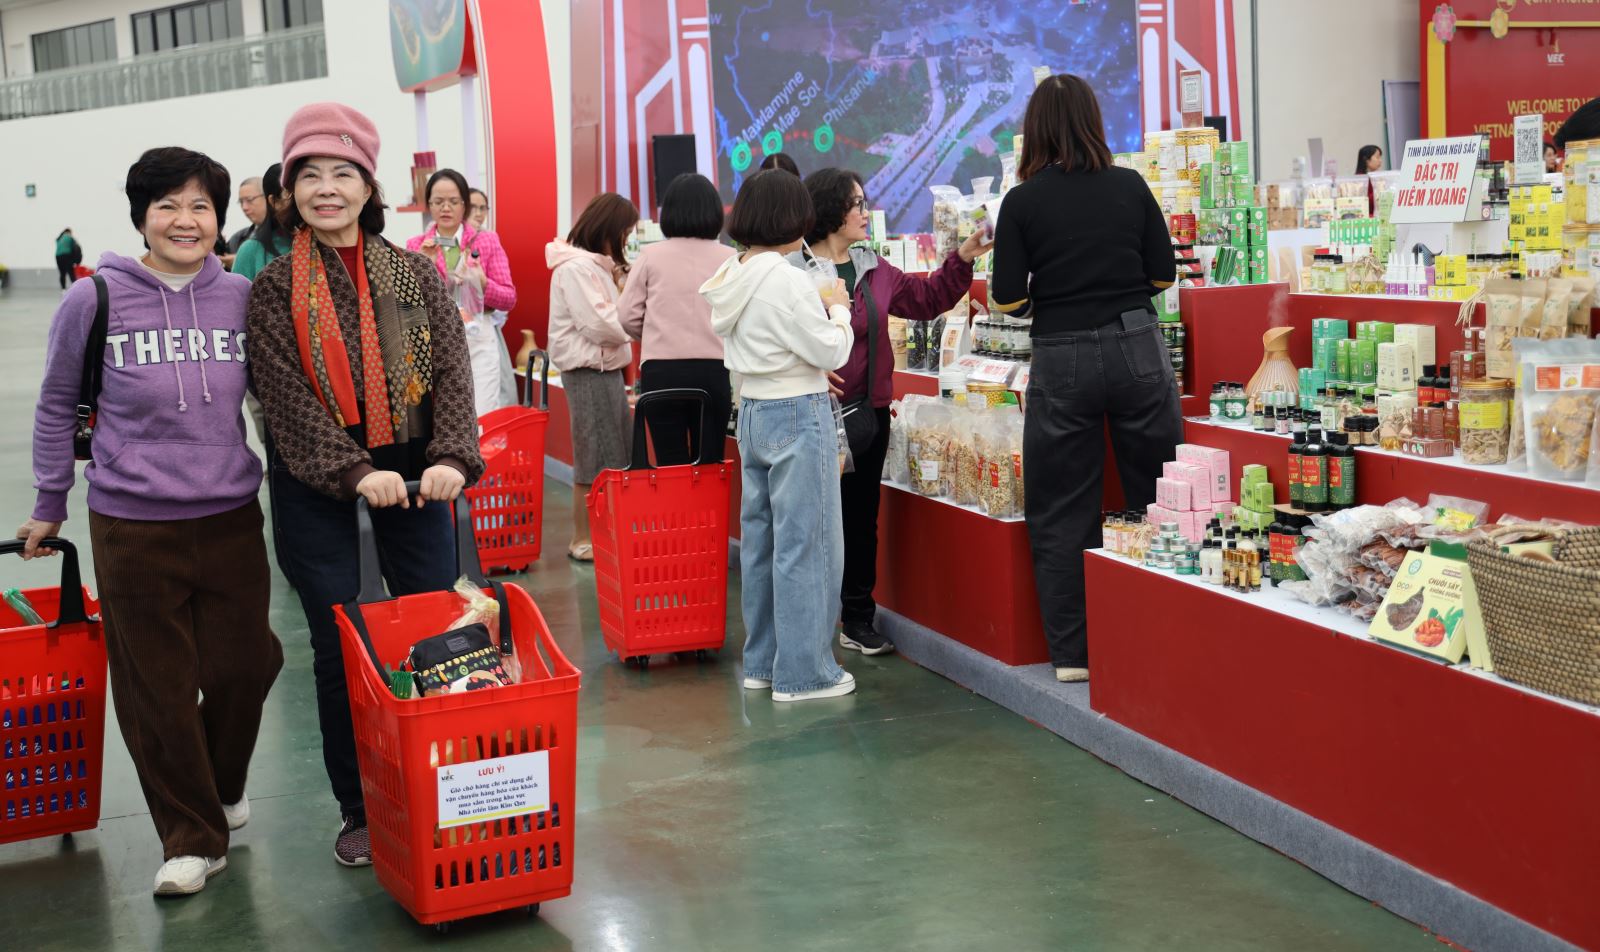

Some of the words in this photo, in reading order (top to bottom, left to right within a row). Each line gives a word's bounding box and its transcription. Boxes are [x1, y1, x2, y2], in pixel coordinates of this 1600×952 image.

[1547, 53, 1565, 63] VEC
[736, 71, 804, 144] Mawlamyine
[772, 107, 801, 135] Mae
[798, 79, 820, 107] Sot
[1507, 99, 1564, 115] WELCOME
[1566, 98, 1580, 112] TO
[1474, 122, 1513, 138] VIETNA
[1435, 145, 1448, 156] HOA
[1413, 160, 1438, 184] ĐẶC
[1440, 162, 1459, 183] TRỊ
[1397, 186, 1426, 207] VIÊM
[1427, 187, 1467, 206] XOANG
[478, 767, 494, 777] LƯU
